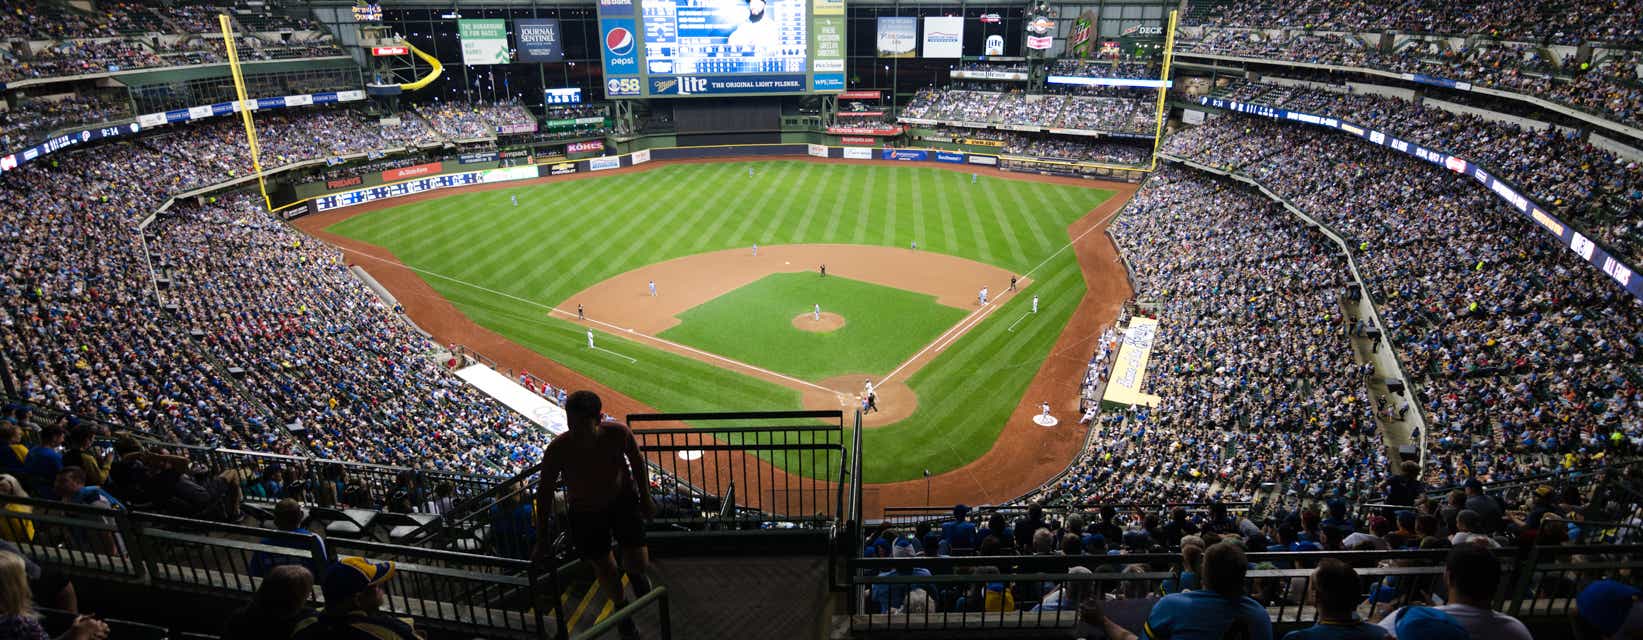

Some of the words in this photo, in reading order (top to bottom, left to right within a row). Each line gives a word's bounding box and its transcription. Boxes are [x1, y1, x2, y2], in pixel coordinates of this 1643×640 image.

[521, 34, 555, 42] SENTINEL
[988, 40, 1001, 48] Lite
[611, 57, 634, 67] pepsi
[620, 79, 640, 92] 58
[677, 76, 708, 95] Lite
[101, 127, 119, 138] 9:14
[1602, 256, 1616, 276] ALL
